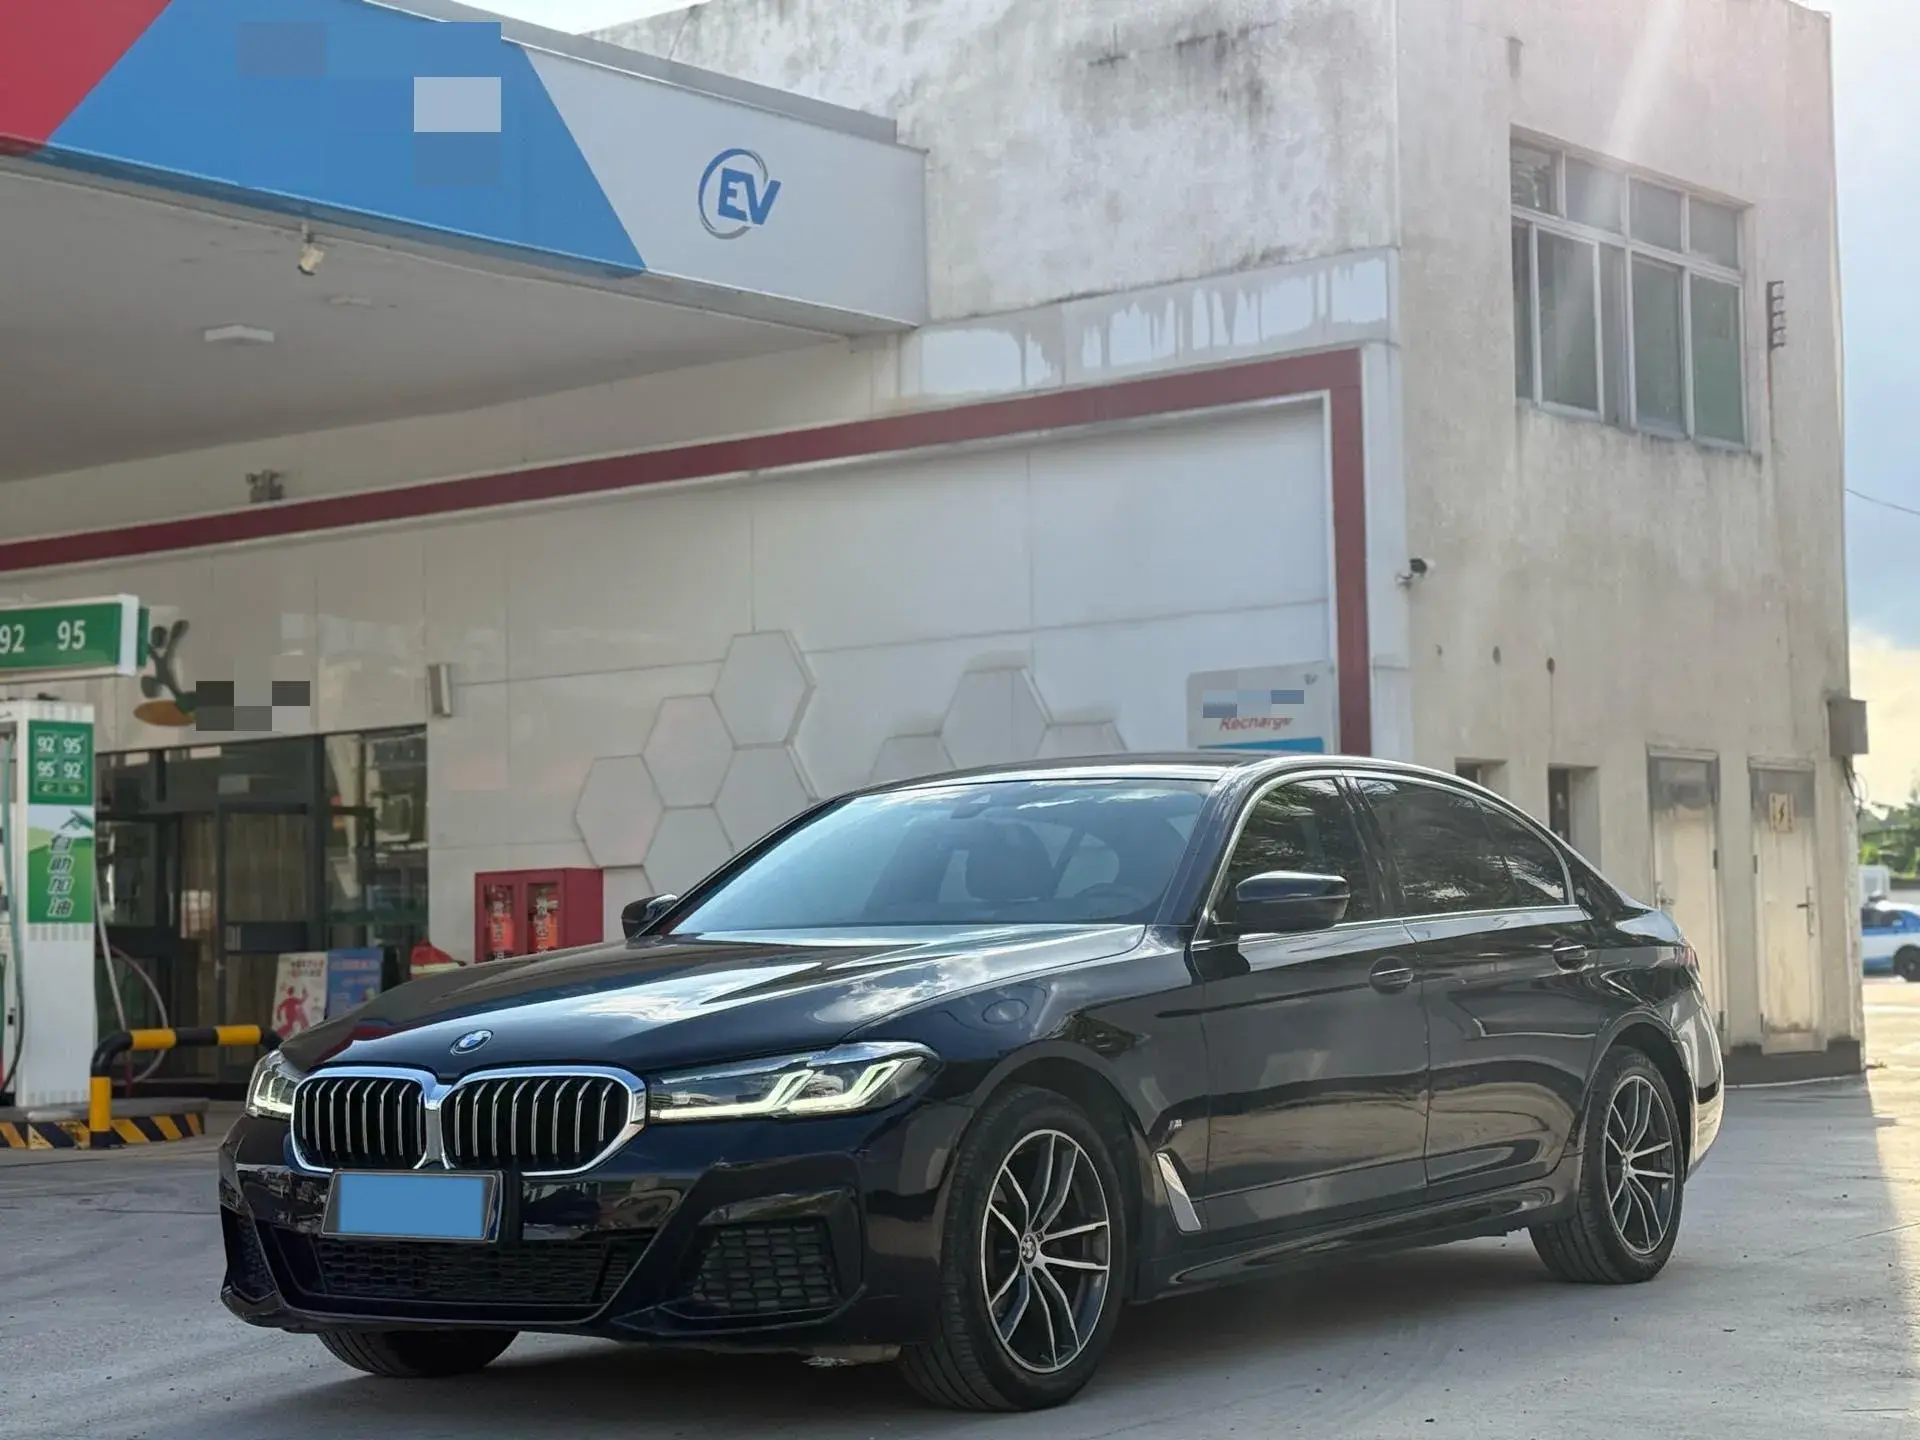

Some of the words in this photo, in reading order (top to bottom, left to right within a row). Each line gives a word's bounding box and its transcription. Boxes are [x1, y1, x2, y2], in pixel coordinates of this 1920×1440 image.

[718, 167, 782, 225] EV
[0, 624, 25, 654] 92
[57, 620, 86, 651] 95
